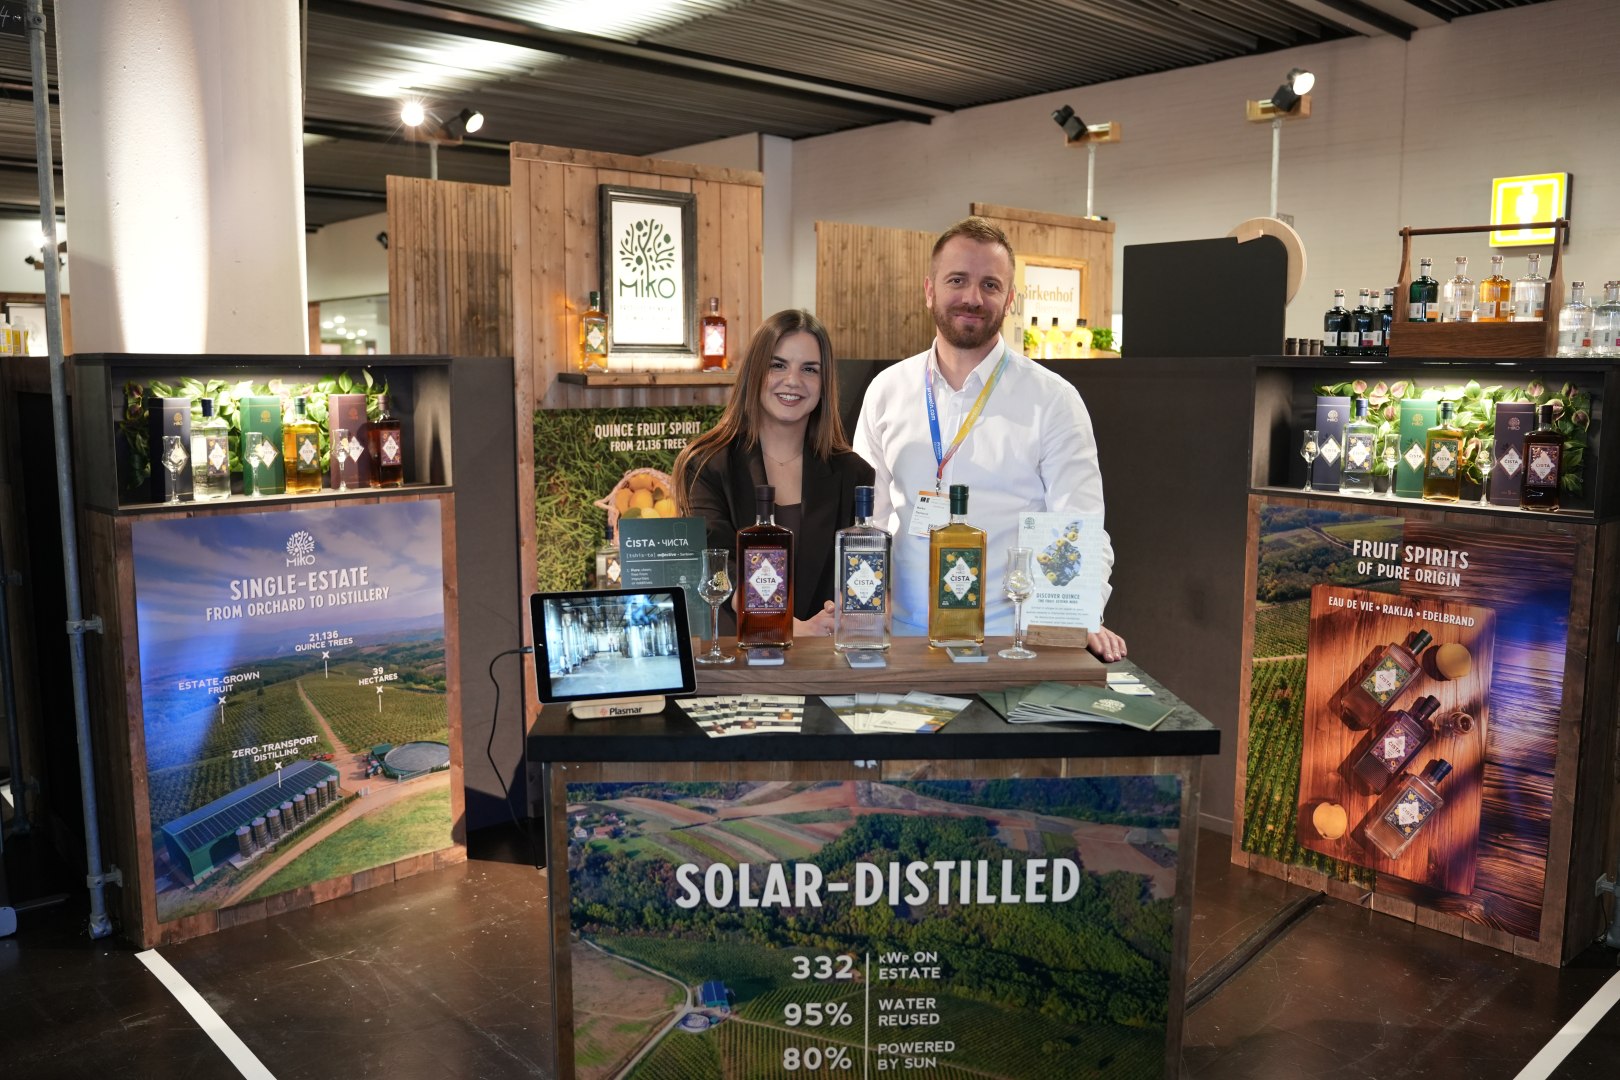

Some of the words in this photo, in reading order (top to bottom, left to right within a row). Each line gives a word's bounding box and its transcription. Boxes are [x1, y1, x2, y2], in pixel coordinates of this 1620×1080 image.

[595, 424, 633, 439] QUINCE
[638, 422, 665, 435] FRUIT
[670, 421, 701, 435] SPIRIT
[610, 441, 633, 452] FROM
[636, 440, 661, 451] 21,136
[664, 439, 687, 449] TREES
[662, 539, 688, 547] ЧИСТА
[1353, 540, 1399, 560] FRUIT
[1404, 545, 1469, 569] SPIRITS
[756, 576, 776, 584] ČISTA
[1358, 561, 1373, 575] OF
[1378, 563, 1410, 580] PURE
[1415, 568, 1461, 587] ORIGIN
[230, 566, 369, 600] SINGLE-ESTATE
[854, 577, 875, 586] ČISTA
[206, 606, 242, 621] FROM
[248, 598, 305, 616] ORCHARD
[310, 596, 324, 609] TO
[328, 587, 390, 607] DISTILLERY
[1328, 596, 1344, 607] EAU
[1347, 599, 1357, 609] DE
[1360, 601, 1373, 612] VIE
[1383, 605, 1414, 618] RAKIJA
[1423, 611, 1474, 627] EDELBRAND
[295, 640, 327, 652] QUINCE
[329, 637, 353, 647] TREES
[373, 667, 383, 675] 39
[178, 671, 260, 691] ESTATE-GROWN
[358, 673, 398, 686] HECTARES
[208, 685, 233, 695] FRUIT
[610, 707, 642, 716] Plasmar
[232, 735, 318, 758] ZERO-TRANSPORT
[254, 748, 298, 762] DISTILLING
[675, 858, 1080, 908] SOLAR-DISTILLED
[914, 951, 938, 963] ON
[791, 955, 853, 980] 332
[879, 967, 940, 980] ESTATE
[879, 998, 936, 1011] WATER
[784, 1003, 852, 1026] 95%
[879, 1012, 940, 1026] REUSED
[878, 1040, 955, 1054] POWERED
[783, 1047, 852, 1071] 80%
[878, 1058, 899, 1071] BY
[904, 1057, 937, 1069] SUN
